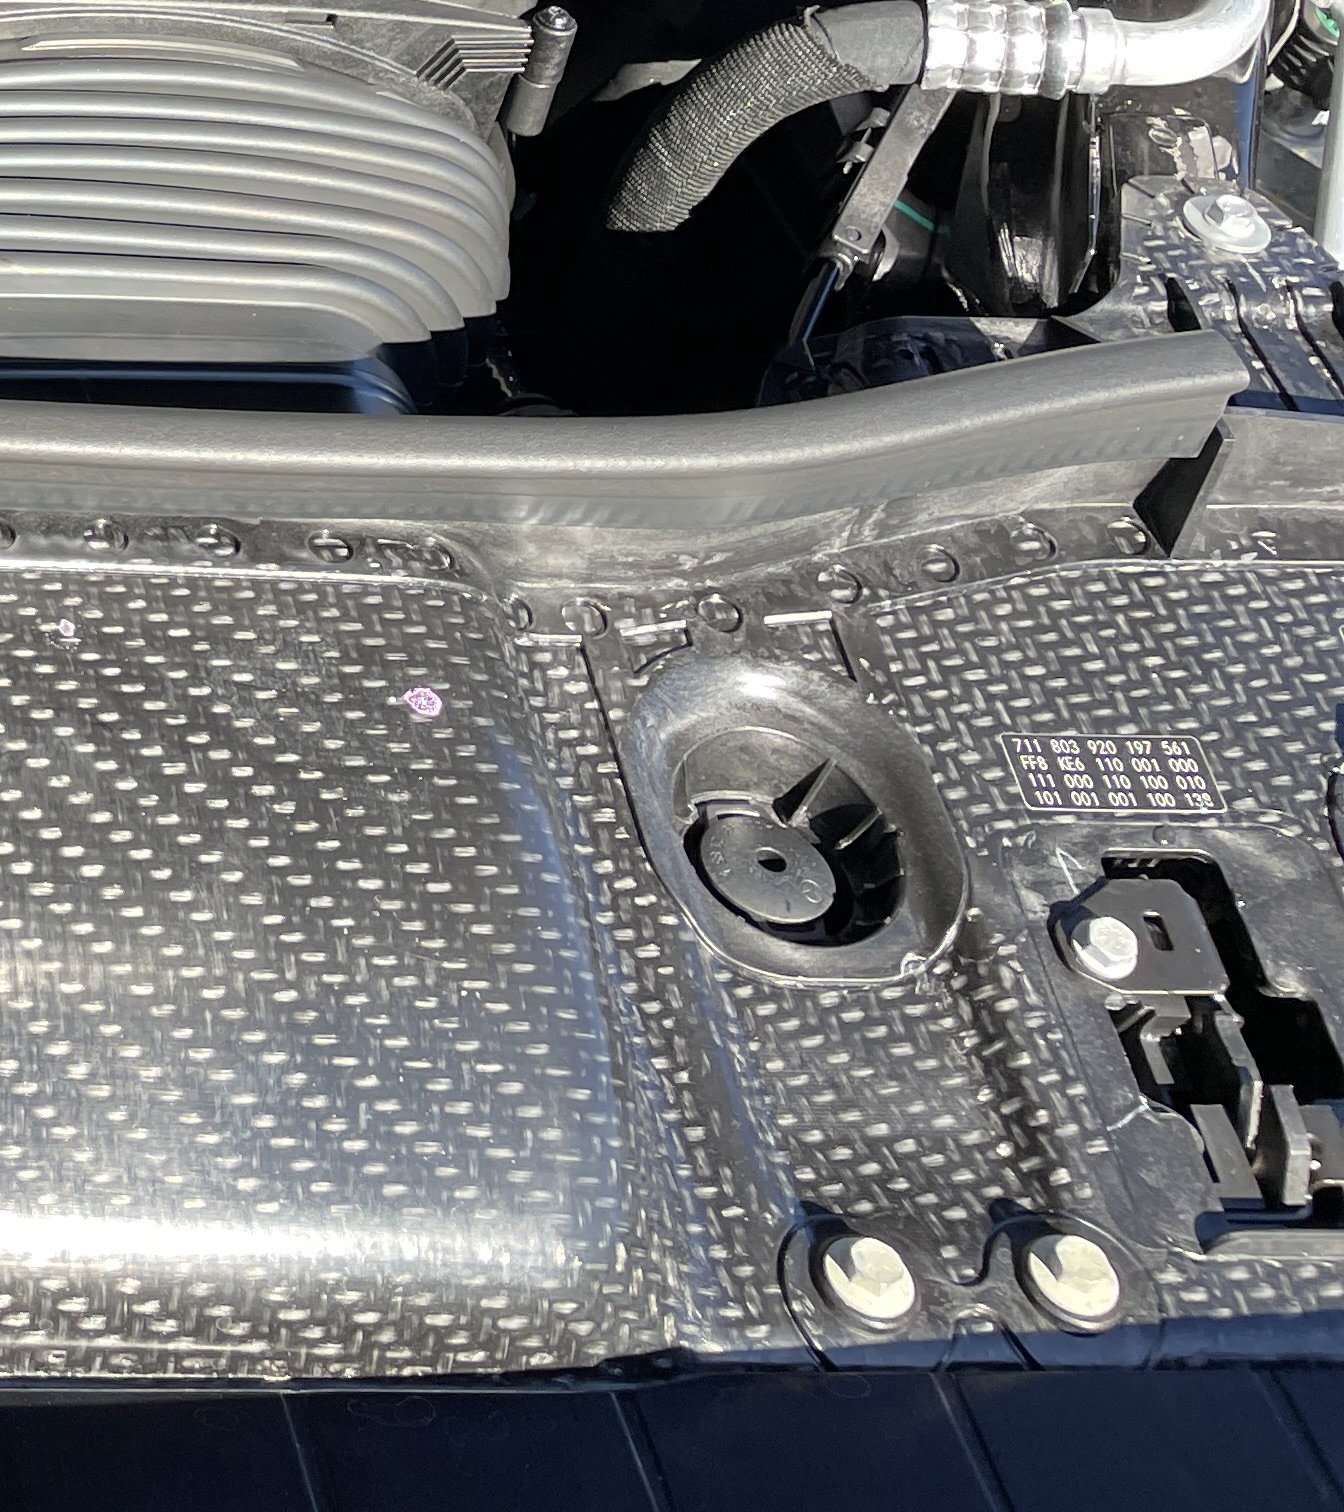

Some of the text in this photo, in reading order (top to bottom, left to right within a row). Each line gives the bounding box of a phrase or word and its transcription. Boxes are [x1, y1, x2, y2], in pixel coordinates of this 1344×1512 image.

[1012, 738, 1191, 755] 711 803 920 197 561
[1019, 755, 1199, 773] FF8 KE6 110 001 000
[1028, 772, 1206, 790] 111 000 110 100 010
[1034, 790, 1063, 805] 101
[1070, 791, 1100, 806] 001
[1108, 792, 1138, 807] 001
[1146, 792, 1176, 807] 100
